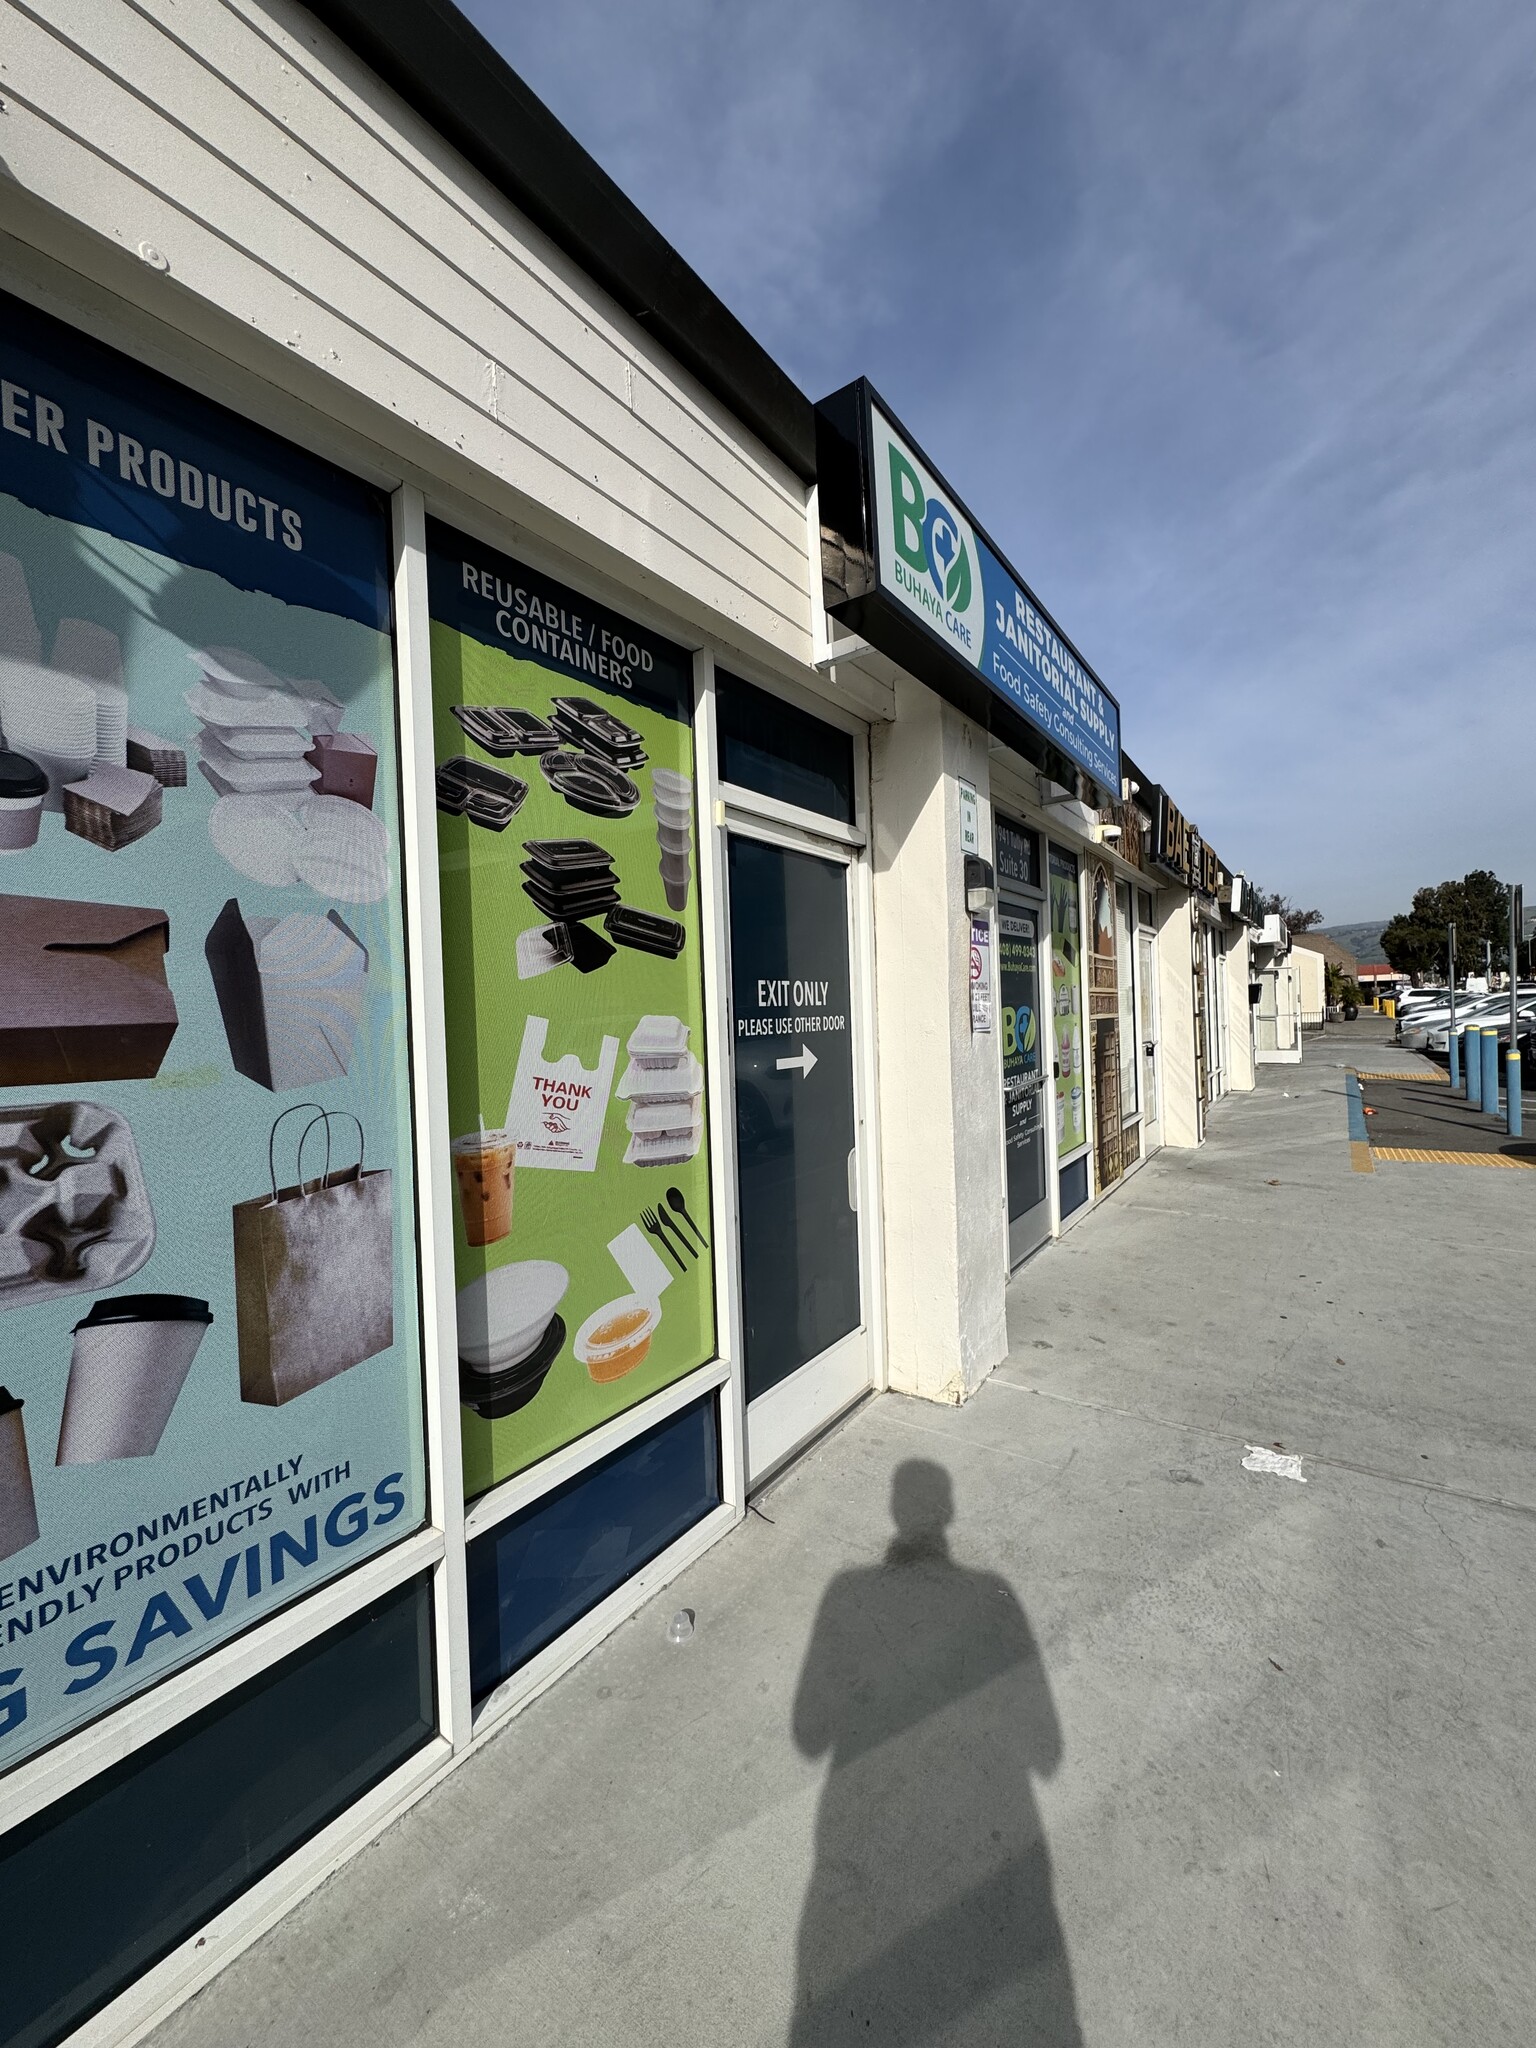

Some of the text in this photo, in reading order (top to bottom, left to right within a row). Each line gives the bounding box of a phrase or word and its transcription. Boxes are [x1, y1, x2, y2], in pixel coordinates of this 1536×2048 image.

[87, 418, 303, 551] PRODUCTS
[462, 561, 653, 673] REUSABLE / FOOD
[895, 560, 972, 649] BUHAYA CARE
[496, 610, 633, 689] CONTAINERS
[996, 600, 1115, 752] JANITORIAL SUPPLY
[1015, 590, 1104, 718] RESTAURANT &
[993, 651, 1118, 787] Food Safety Consulting Services
[1062, 706, 1074, 726] and
[999, 850, 1029, 881] Suite 30
[1167, 799, 1190, 874] BAE
[738, 1015, 845, 1036] PLEASE USE OTHER DOOR
[757, 980, 829, 1007] EXIT ONLY
[533, 1076, 592, 1098] THANK
[1003, 1052, 1036, 1069] BUHAYA CARE
[1003, 1069, 1038, 1088] RESTAURANT
[541, 1093, 579, 1111] YOU
[1012, 1098, 1032, 1117] SUPPLY
[0, 1454, 304, 1611] ENVIRONMENTALLY
[0, 1461, 351, 1647] NDLY PRODUCTS WITH
[63, 1472, 406, 1695] SAVINGS
